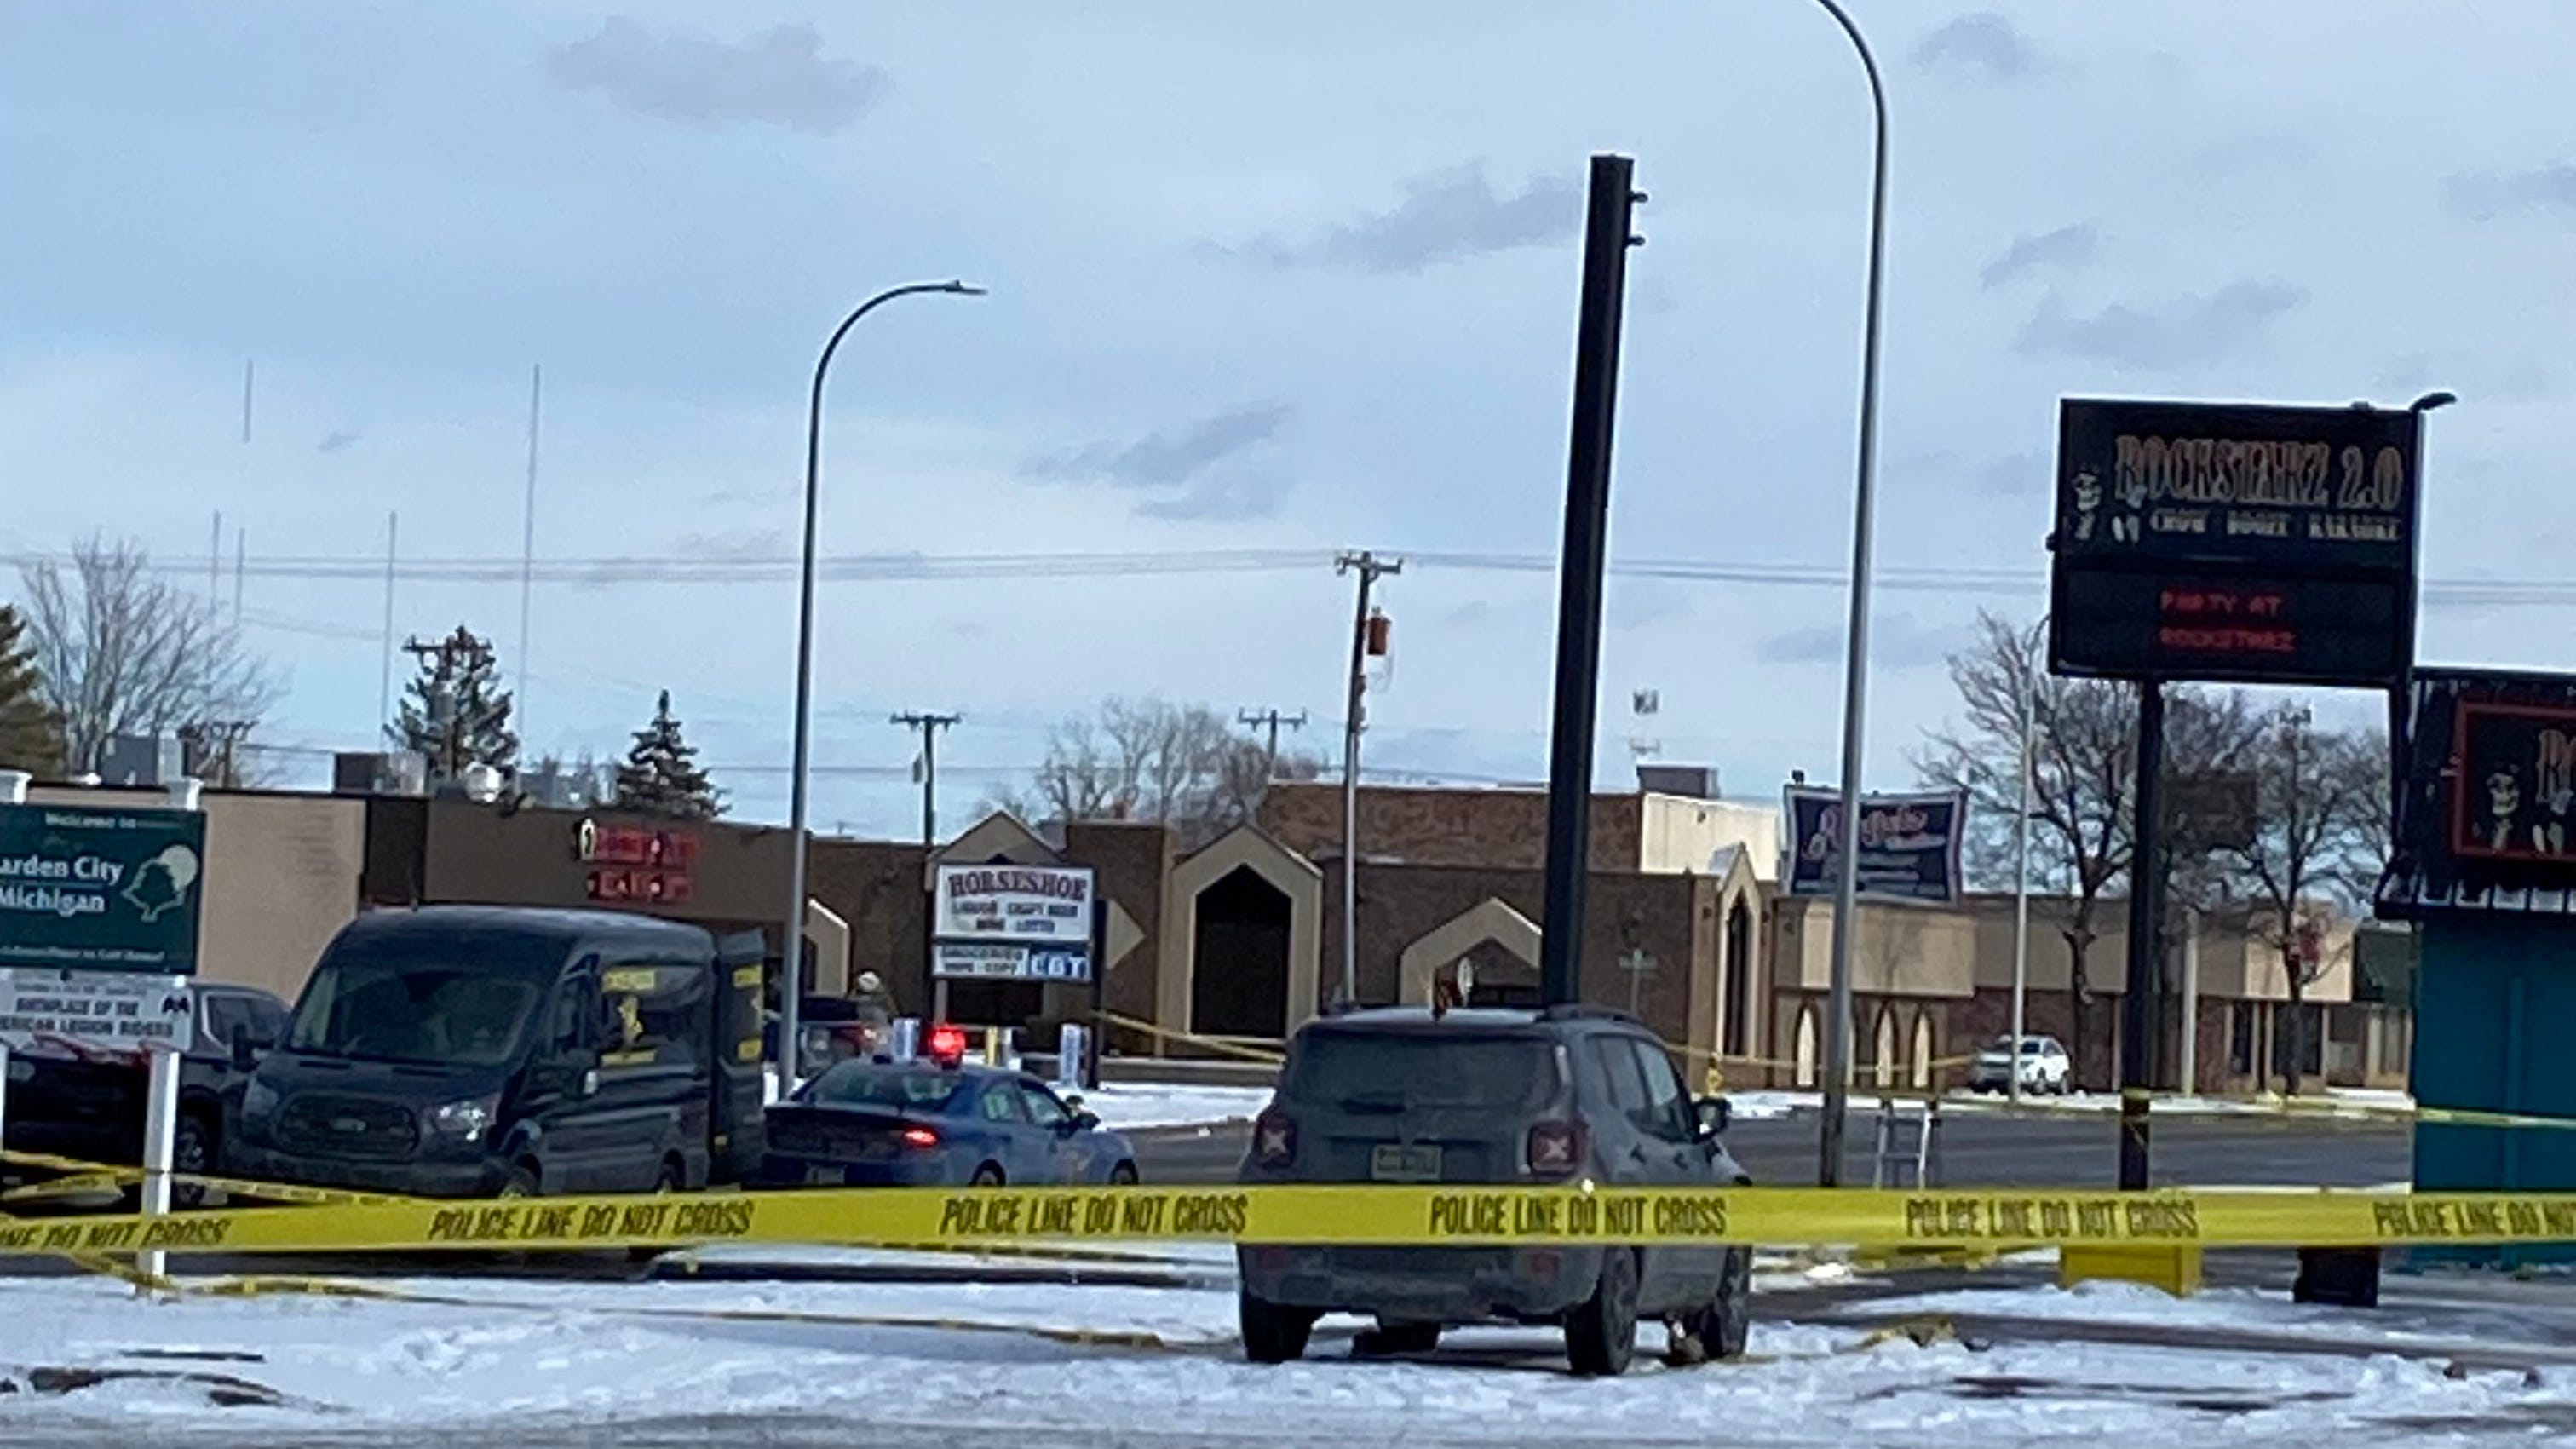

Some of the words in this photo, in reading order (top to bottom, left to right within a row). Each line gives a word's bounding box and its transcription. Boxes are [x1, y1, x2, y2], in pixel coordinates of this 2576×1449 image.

[2337, 445, 2404, 511] 2.0
[2249, 594, 2284, 616] AT
[45, 812, 115, 829] Welcome
[118, 815, 137, 829] to
[0, 854, 69, 877] arden
[74, 856, 124, 886] City
[0, 888, 105, 918] Michigan
[948, 871, 1088, 903] HORSESHOE
[428, 1206, 515, 1240] POLICE
[520, 1205, 577, 1239] LINE
[579, 1204, 614, 1239] DO
[618, 1202, 670, 1238] NOT
[673, 1199, 754, 1237] CROSS
[940, 1195, 1021, 1234] POLICE
[1027, 1195, 1078, 1233] LINE
[1084, 1195, 1116, 1233] DO
[1121, 1195, 1166, 1234] NOT
[1172, 1194, 1247, 1233] CROSS
[1429, 1196, 1506, 1234] POLICE
[1514, 1196, 1561, 1233] LINE
[1567, 1196, 1597, 1233] DO
[1605, 1196, 1648, 1234] NOT
[1653, 1196, 1727, 1234] CROSS
[1906, 1198, 1983, 1238] POLICE
[1987, 1198, 2033, 1238] LINE
[2041, 1199, 2070, 1237] DO
[2077, 1199, 2119, 1238] NOT
[2126, 1199, 2199, 1238] CROSS
[2373, 1201, 2453, 1236] POLICE
[2454, 1201, 2507, 1236] LINE
[2508, 1201, 2540, 1235] DO
[0, 1226, 42, 1246] INE
[43, 1223, 83, 1248] DO
[86, 1222, 140, 1248] NOT
[142, 1218, 231, 1247] CROSS
